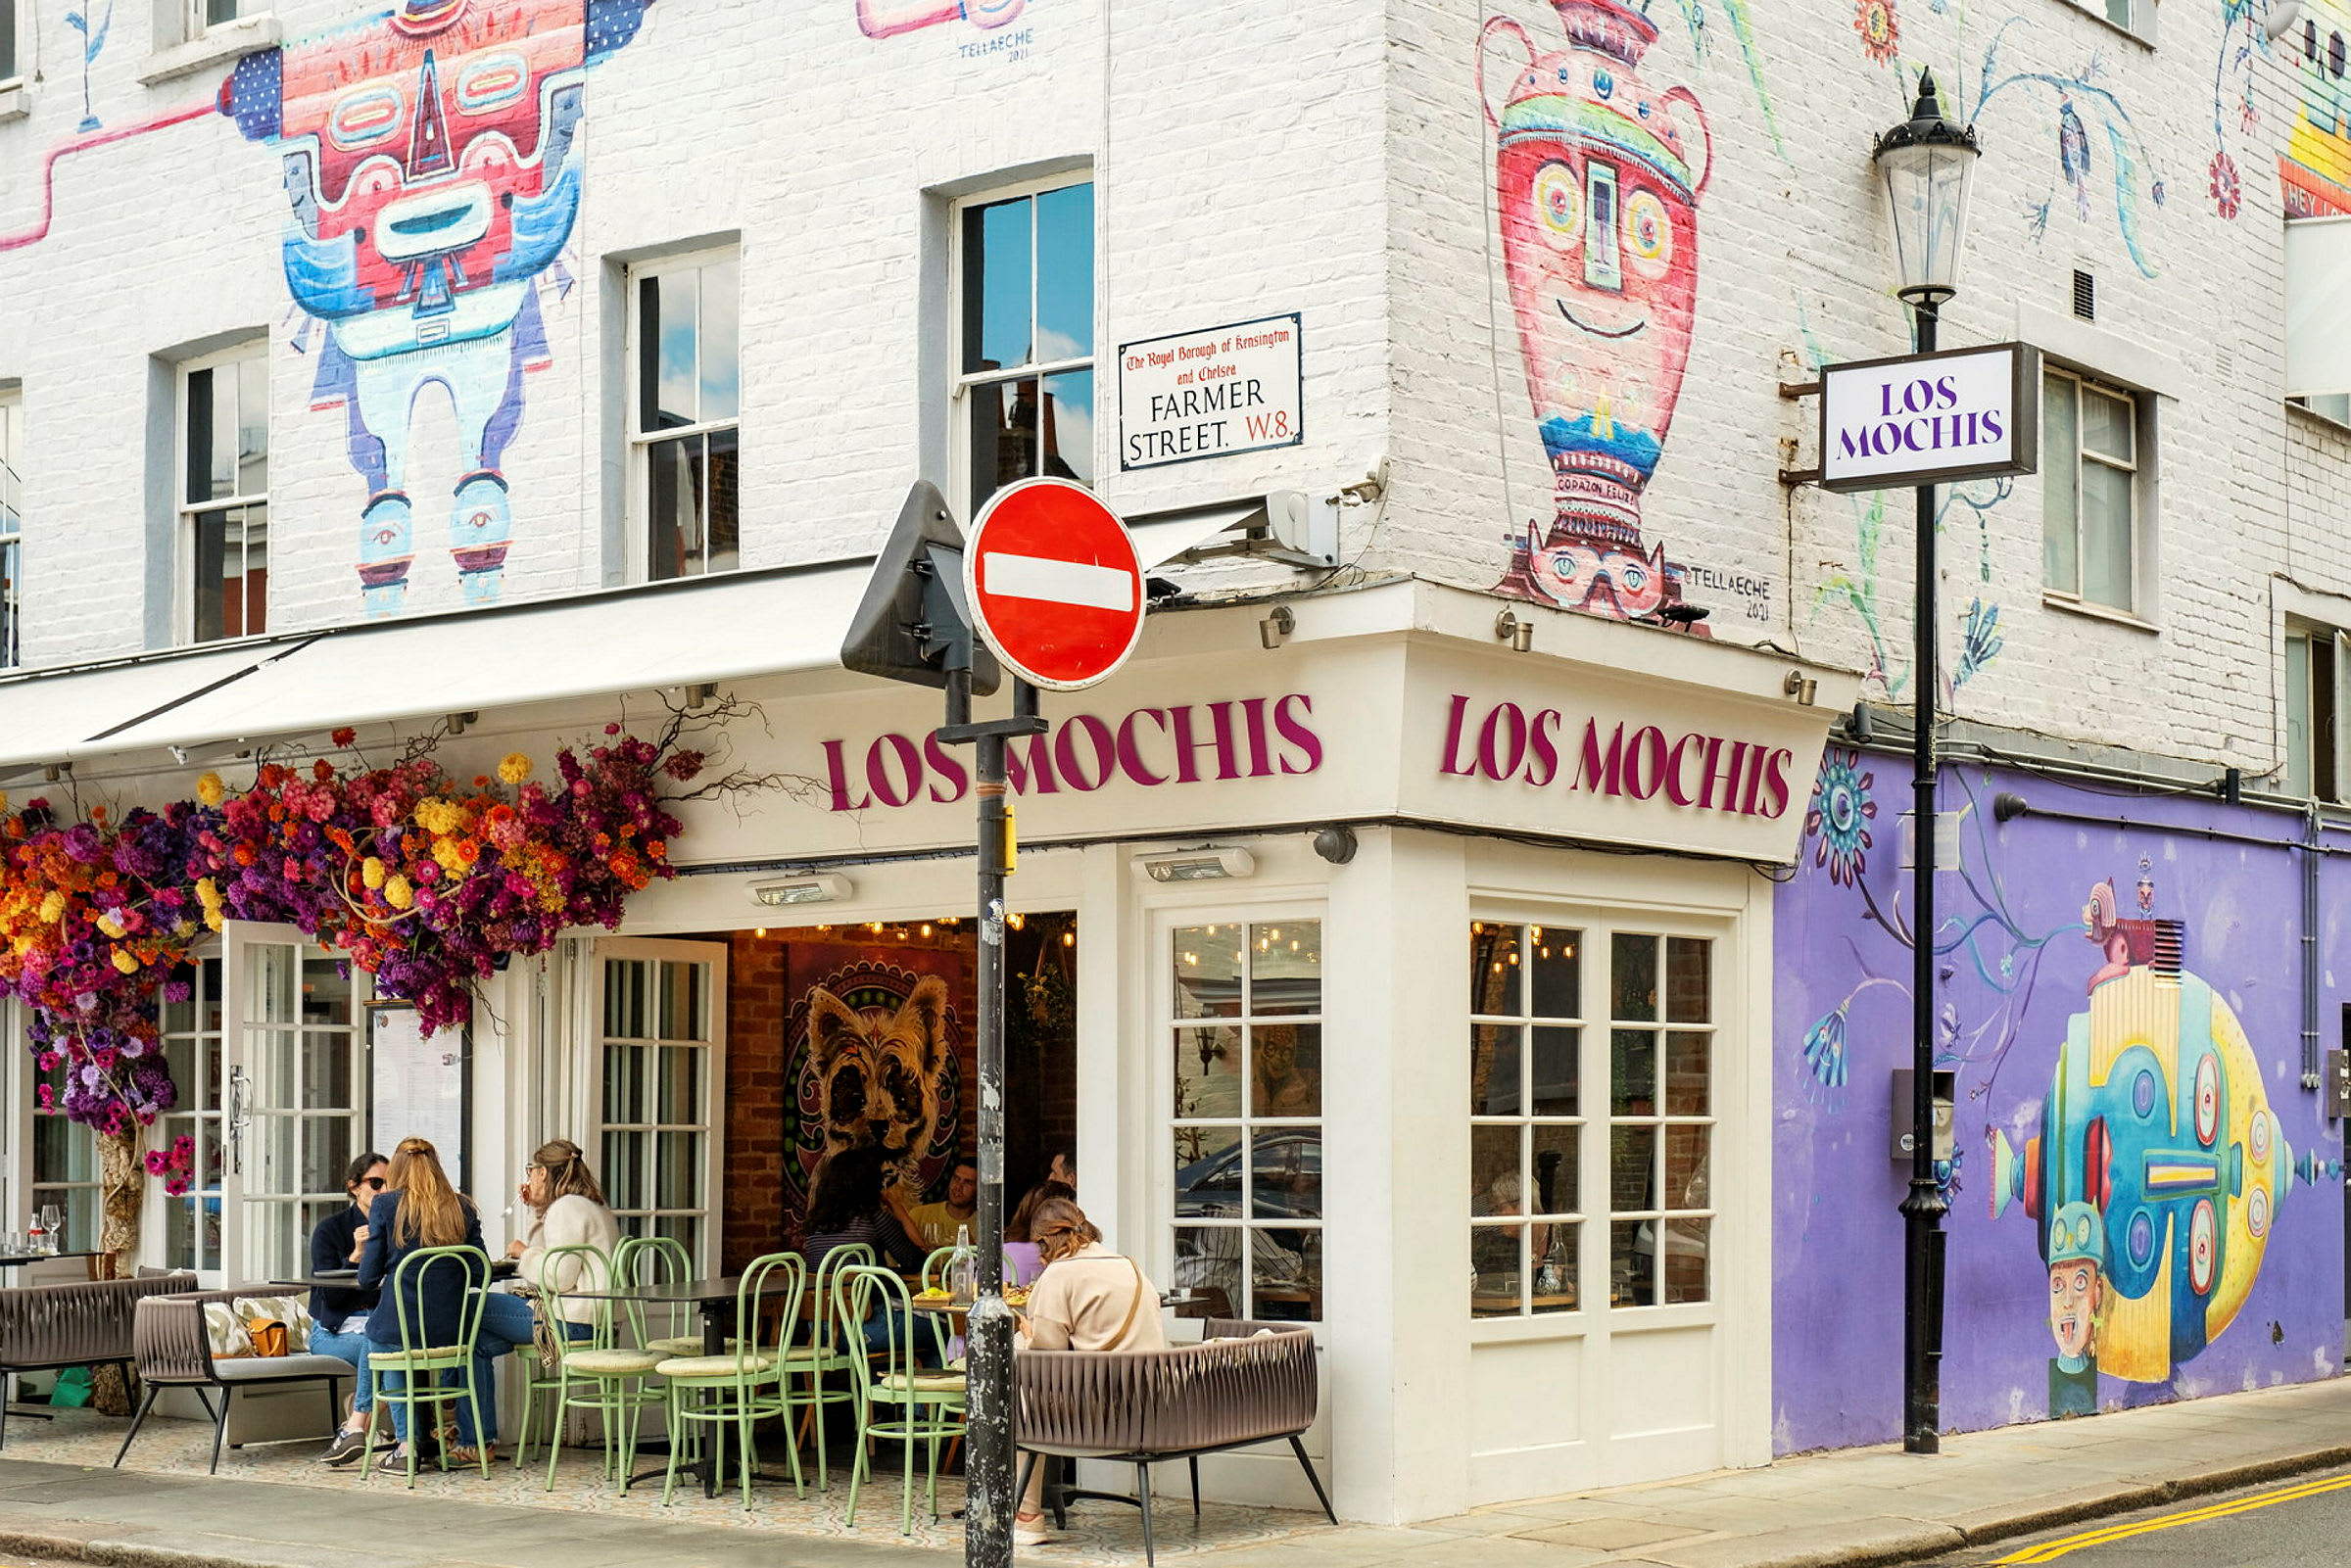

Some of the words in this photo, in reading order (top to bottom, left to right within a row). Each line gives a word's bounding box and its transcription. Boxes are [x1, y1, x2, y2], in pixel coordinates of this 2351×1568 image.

[959, 27, 1033, 58] TELLAECHE
[1127, 356, 1145, 371] The
[1146, 349, 1175, 369] Royal
[1177, 342, 1217, 360] Borough
[1222, 337, 1232, 354] of
[1235, 330, 1290, 350] Kensington
[1177, 369, 1194, 385] and
[1198, 363, 1237, 382] Chelsea
[1150, 378, 1265, 422] FARMER
[1881, 375, 1957, 416] LOS
[1245, 410, 1294, 442] W.8.
[1837, 409, 2003, 460] MOCHIS
[1558, 479, 1602, 494] CORAZON
[1747, 600, 1769, 621] 2021
[820, 729, 969, 812] LOS
[1005, 693, 1323, 796] MOCHIS
[1439, 693, 1561, 787] LOS
[1570, 716, 1794, 820] MOCHIS
